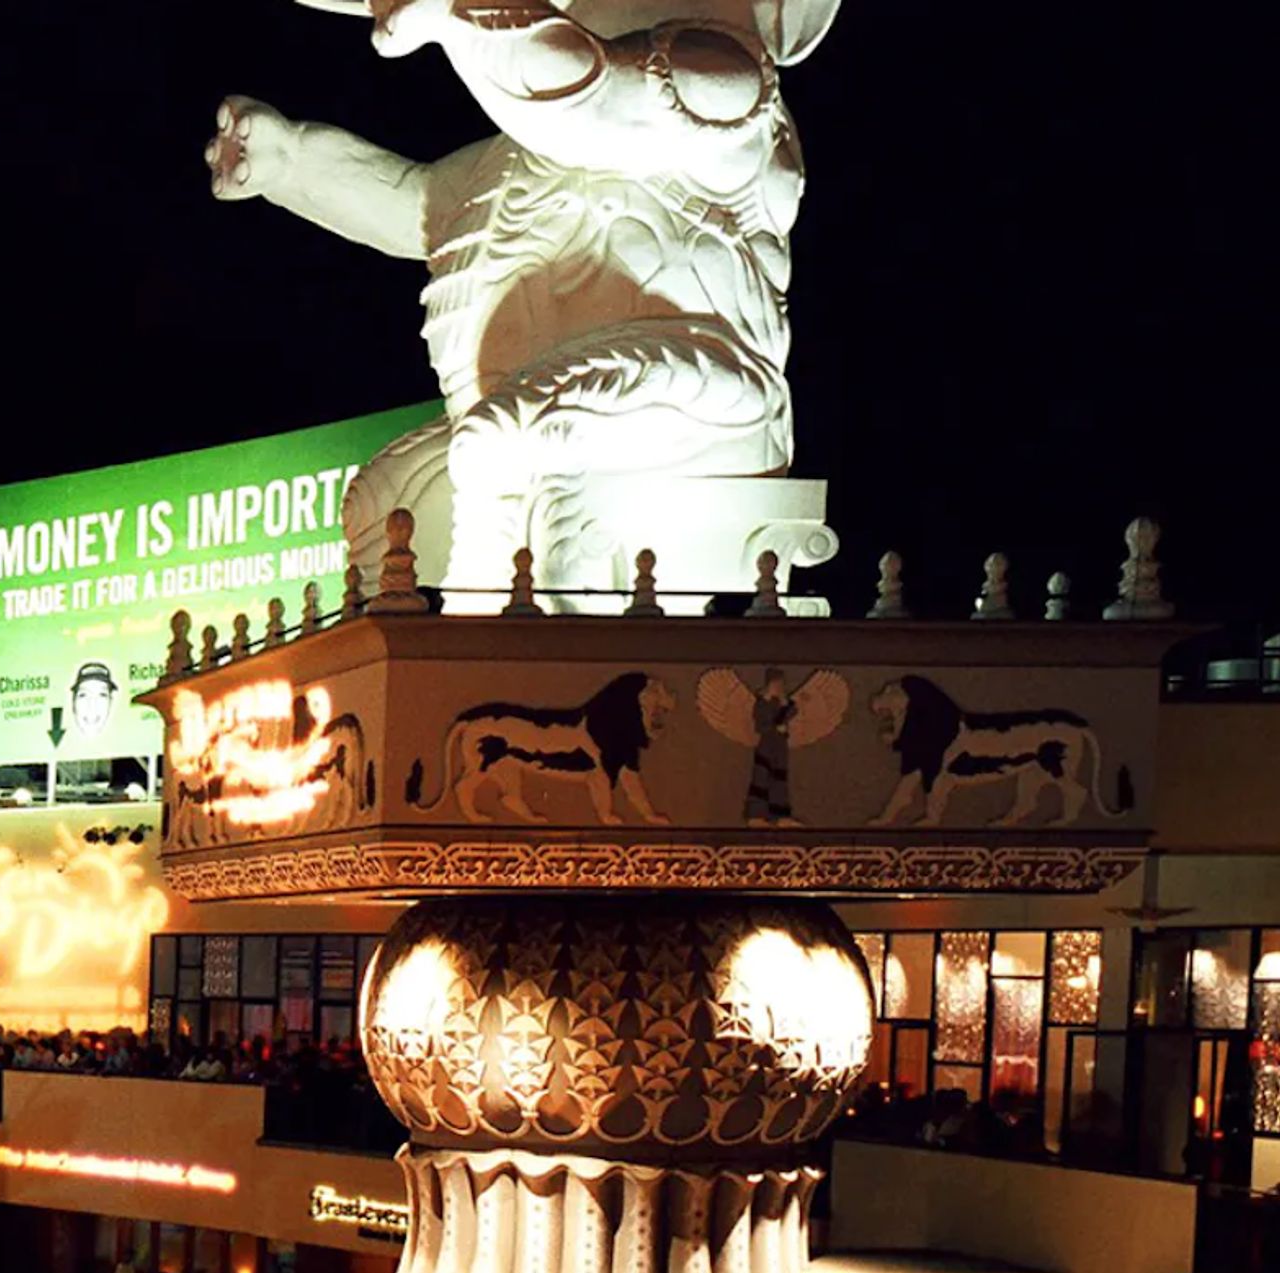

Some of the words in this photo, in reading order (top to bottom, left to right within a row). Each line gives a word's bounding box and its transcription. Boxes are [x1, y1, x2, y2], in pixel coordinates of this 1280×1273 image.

[136, 499, 173, 558] IS
[3, 585, 65, 620] TRADE
[72, 580, 92, 608] IT
[96, 573, 136, 606] FOR
[143, 572, 161, 598] A
[162, 553, 274, 597] DELICIOUS
